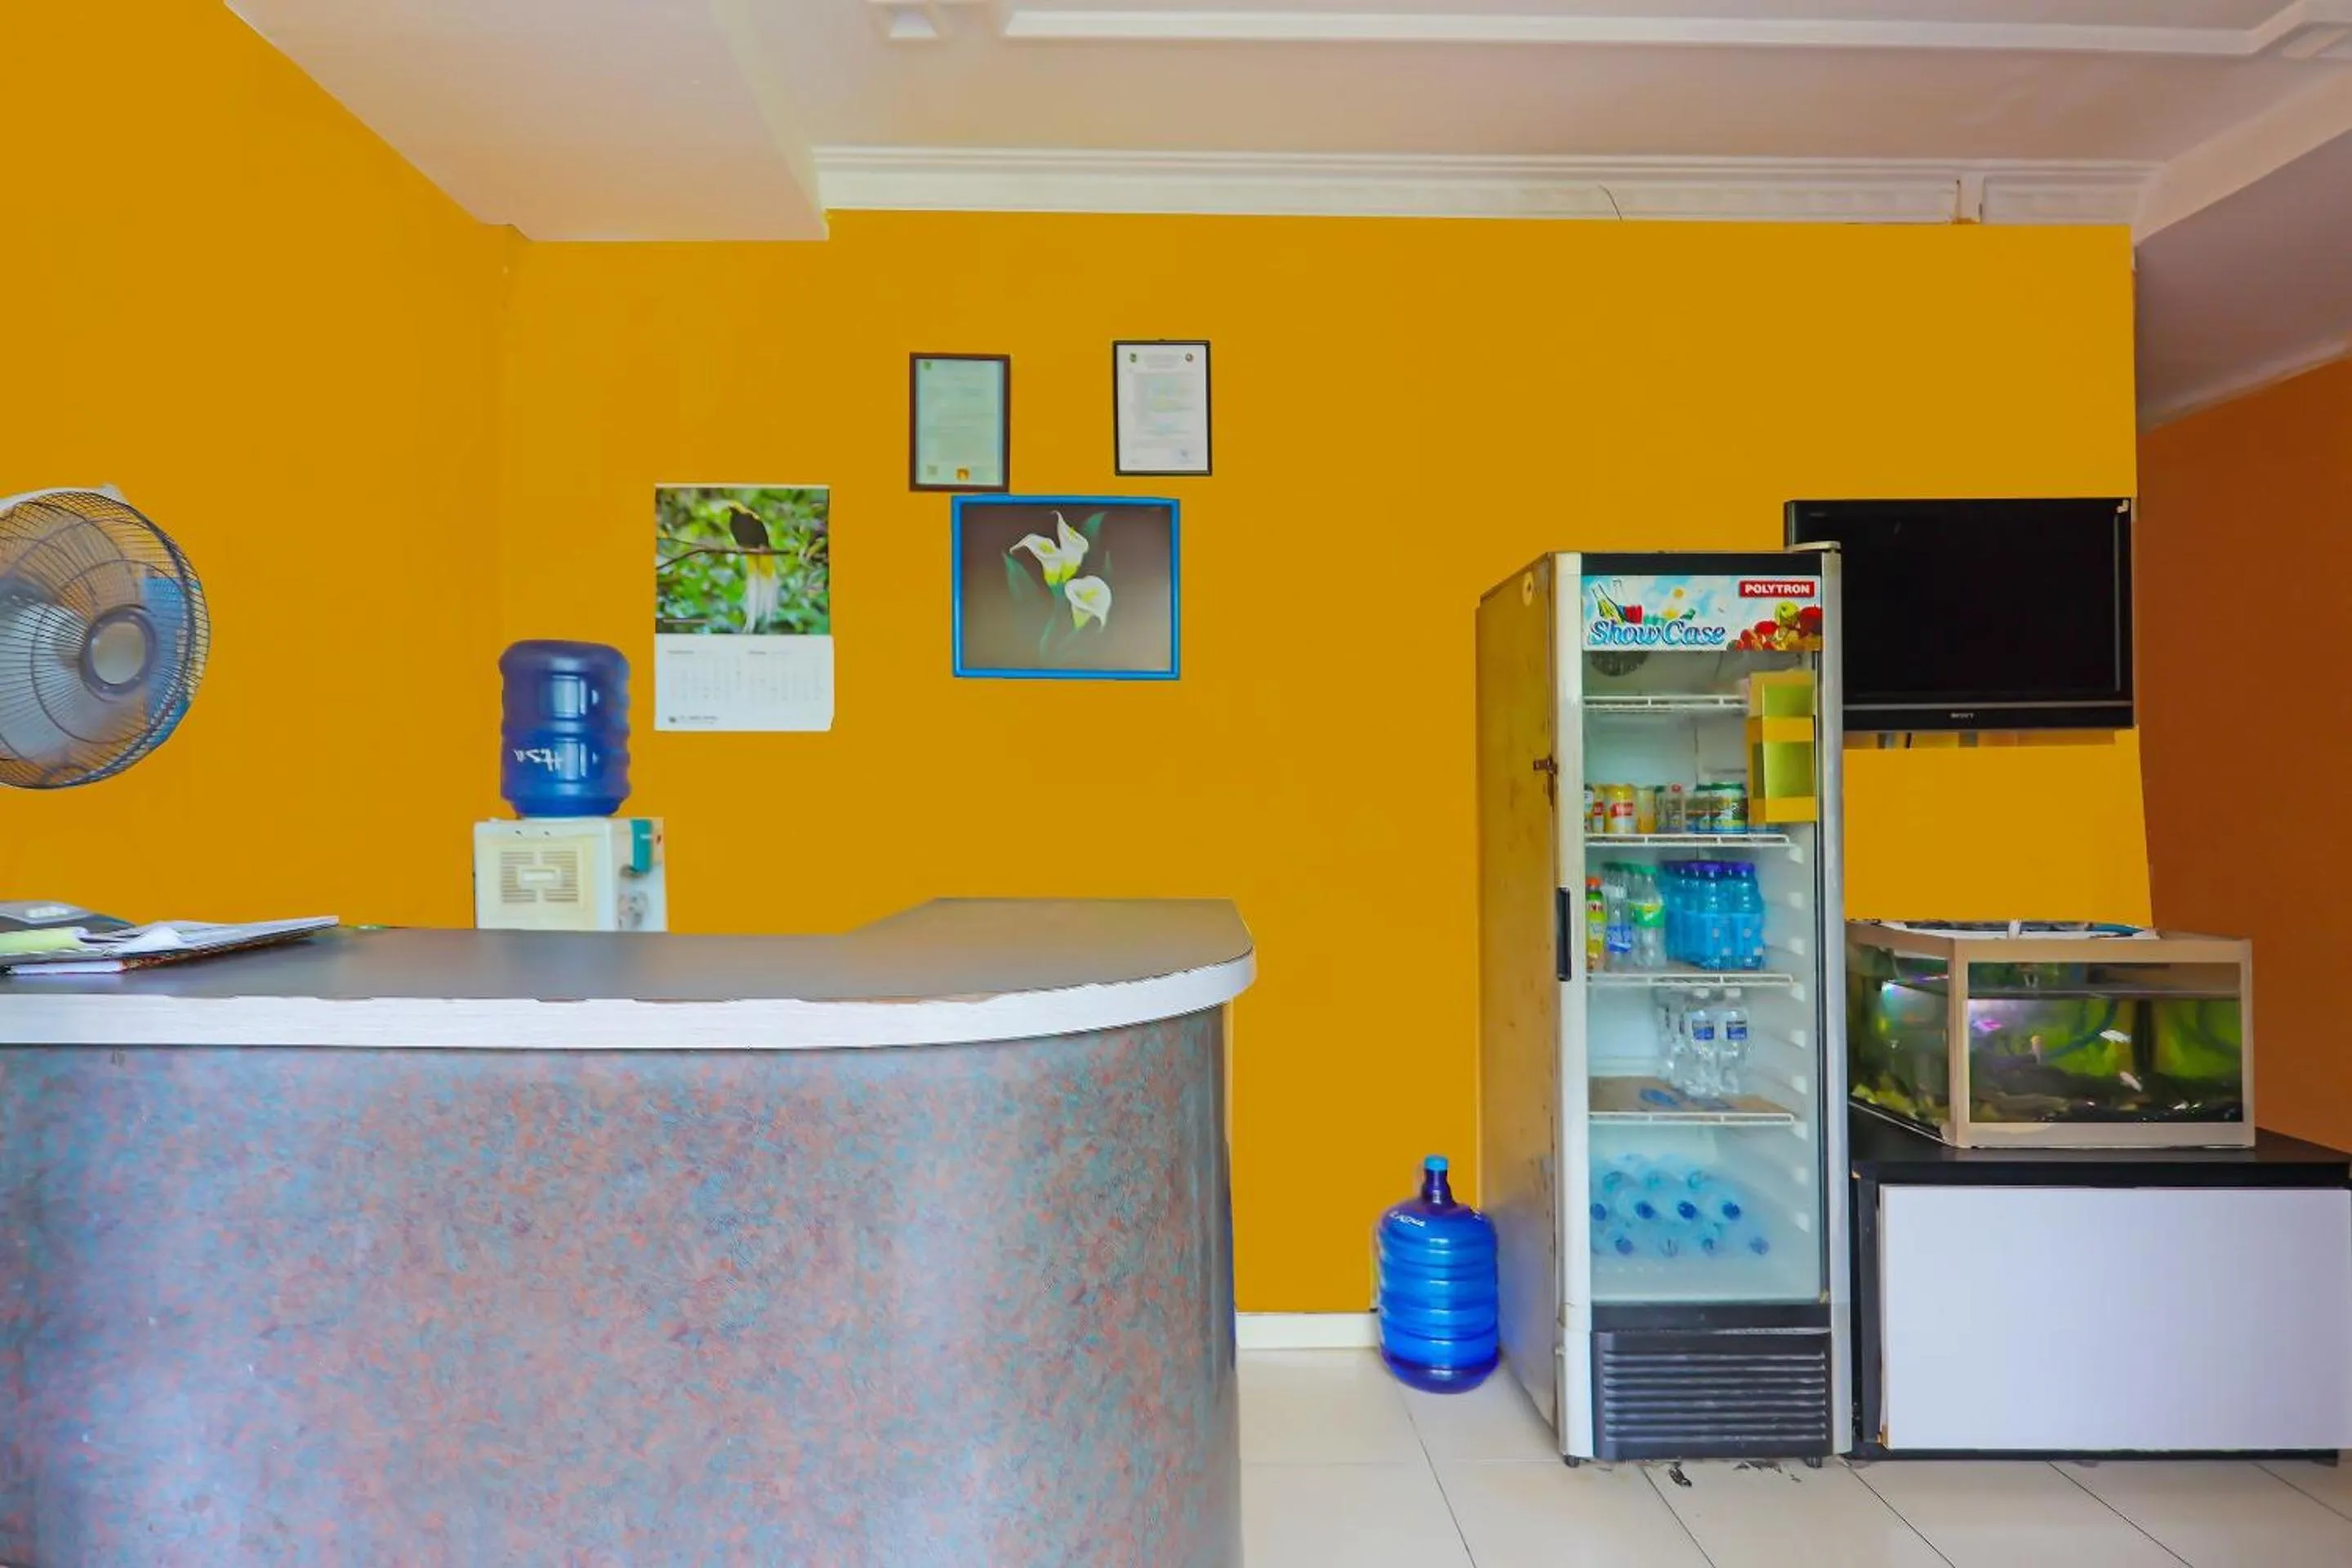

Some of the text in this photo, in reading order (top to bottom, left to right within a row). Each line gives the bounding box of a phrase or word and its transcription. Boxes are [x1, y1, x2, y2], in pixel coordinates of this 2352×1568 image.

[1744, 584, 1811, 595] POLYTRON
[1589, 620, 1726, 645] Show Case
